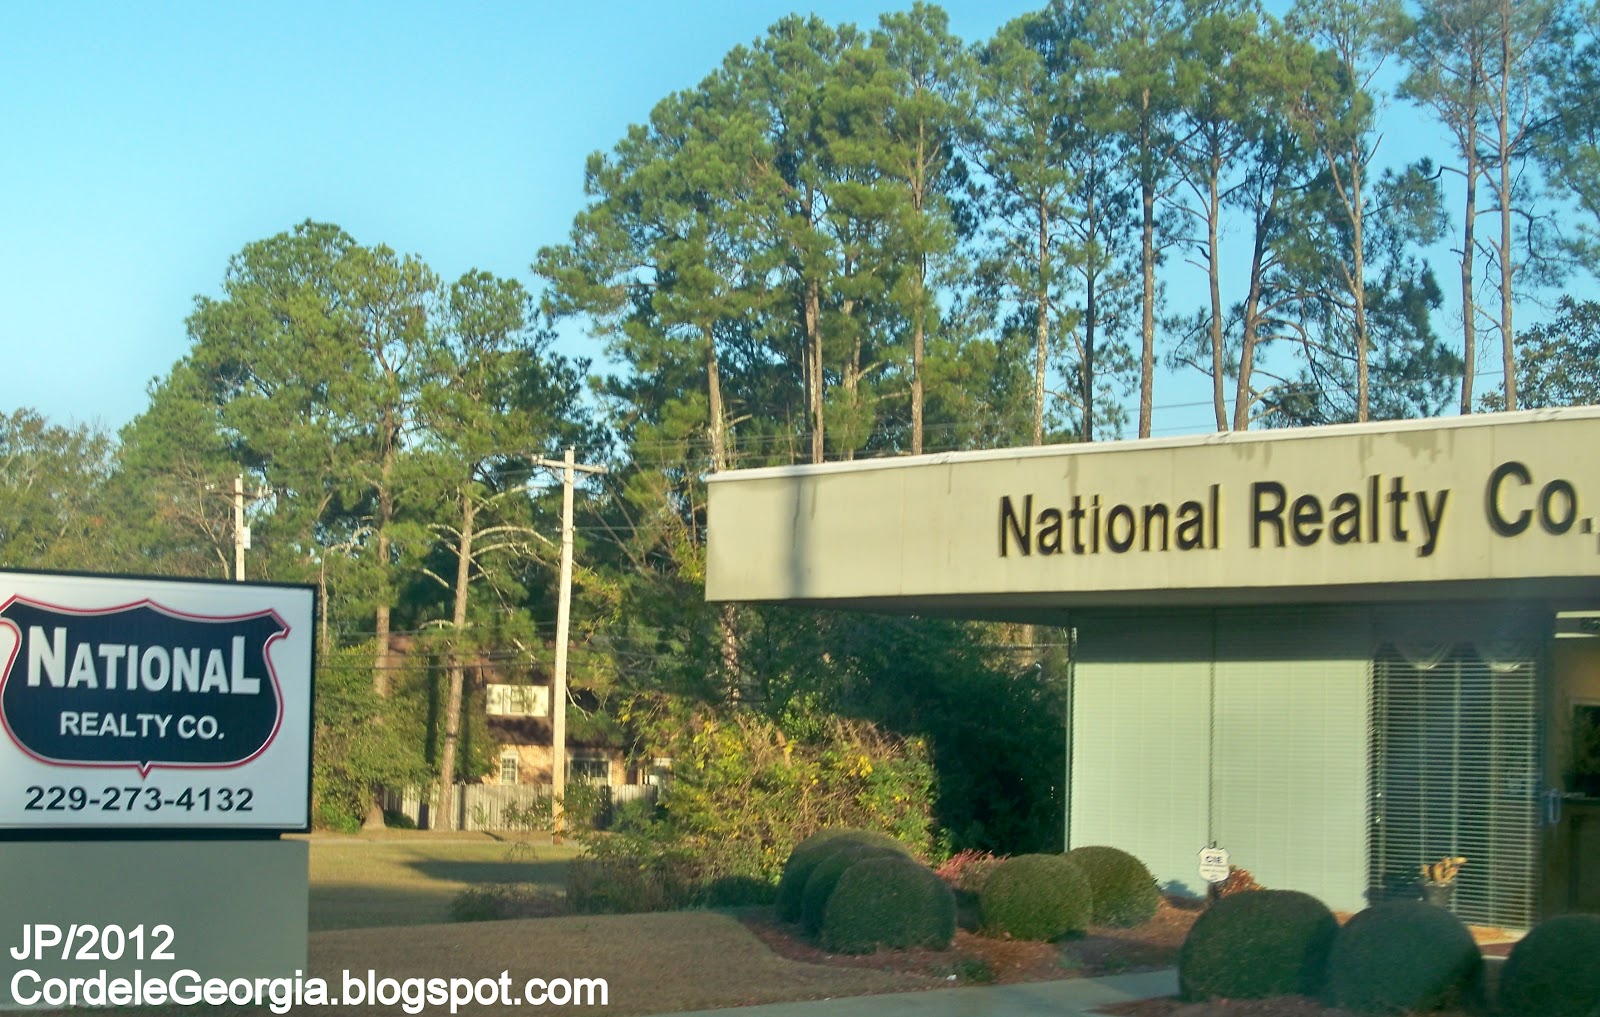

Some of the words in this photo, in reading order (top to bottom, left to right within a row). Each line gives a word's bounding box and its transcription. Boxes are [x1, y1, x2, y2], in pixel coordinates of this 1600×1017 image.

[999, 483, 1220, 558] National
[1249, 474, 1451, 558] Realty
[27, 625, 261, 695] NATIONAL
[59, 711, 173, 739] REALTY
[177, 715, 225, 740] CO.
[24, 785, 254, 812] 229-273-4132
